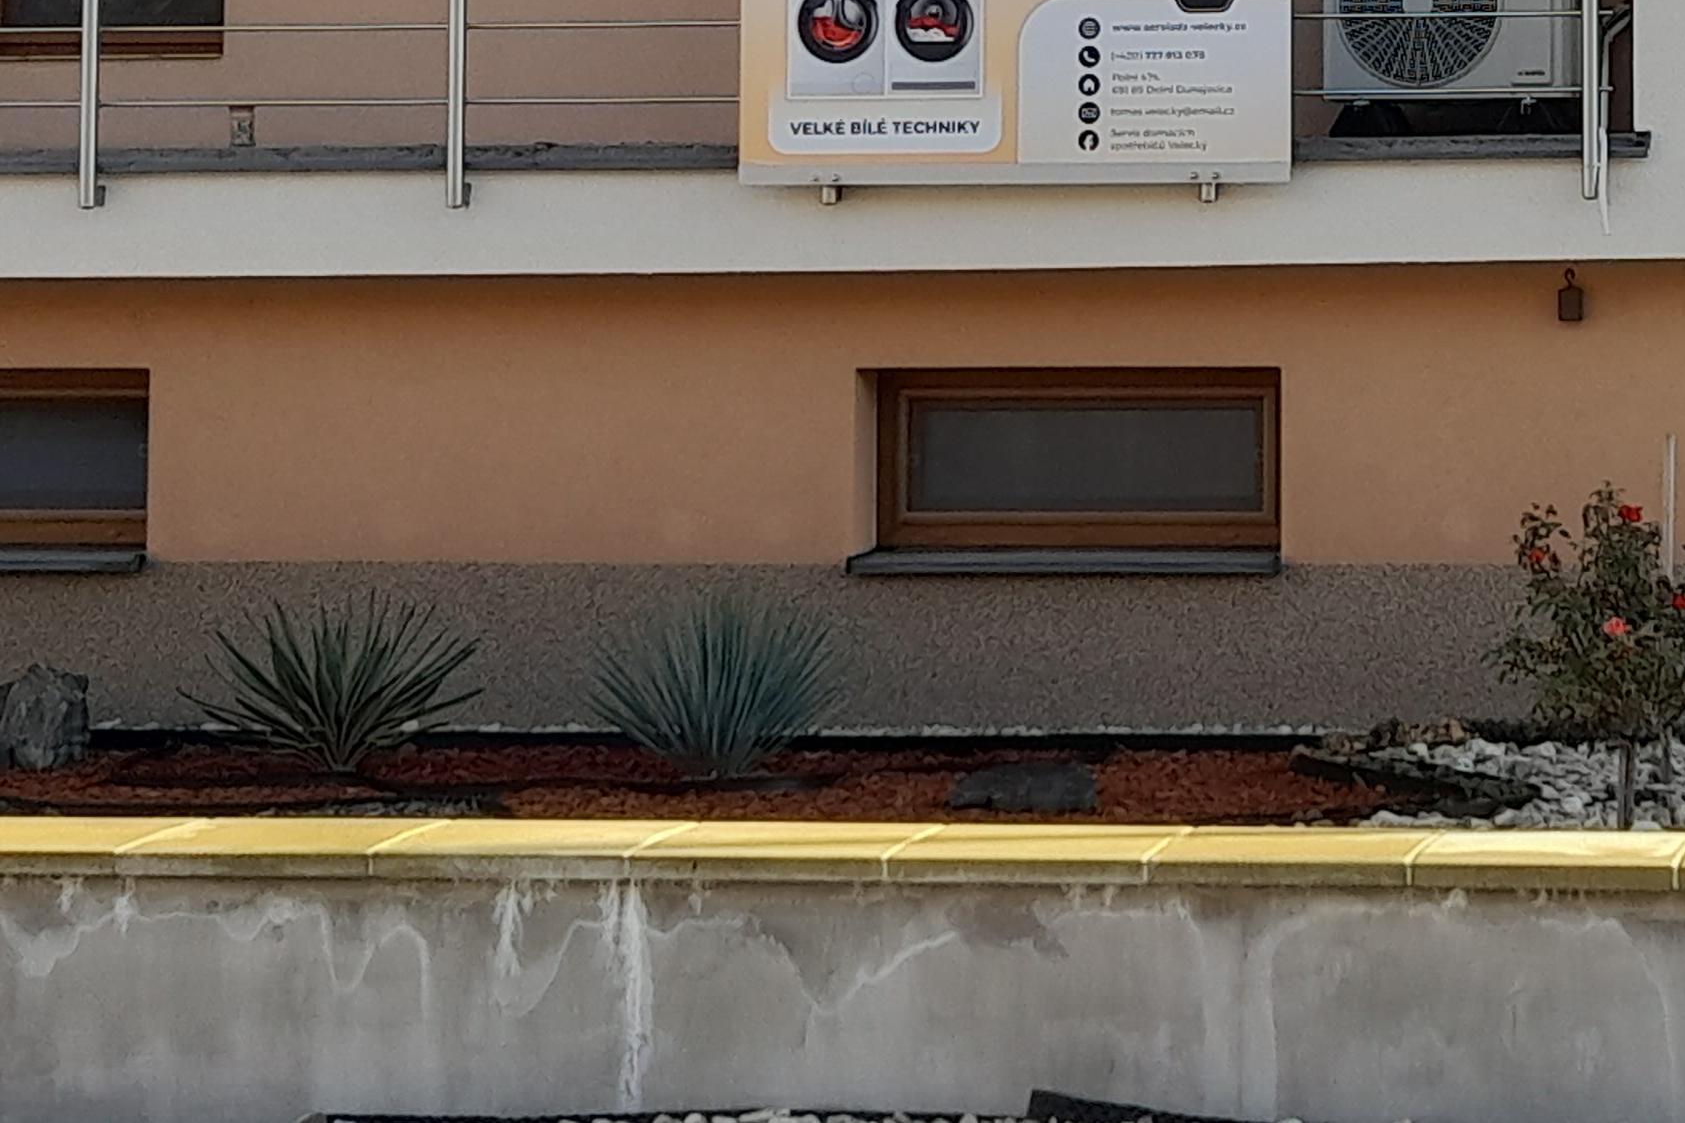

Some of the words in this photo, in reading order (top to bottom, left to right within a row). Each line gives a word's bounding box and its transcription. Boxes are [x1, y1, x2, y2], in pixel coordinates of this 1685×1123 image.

[790, 119, 846, 135] VELKÉ
[850, 118, 888, 135] BÍLÉ
[893, 120, 980, 135] TECHNIKY
